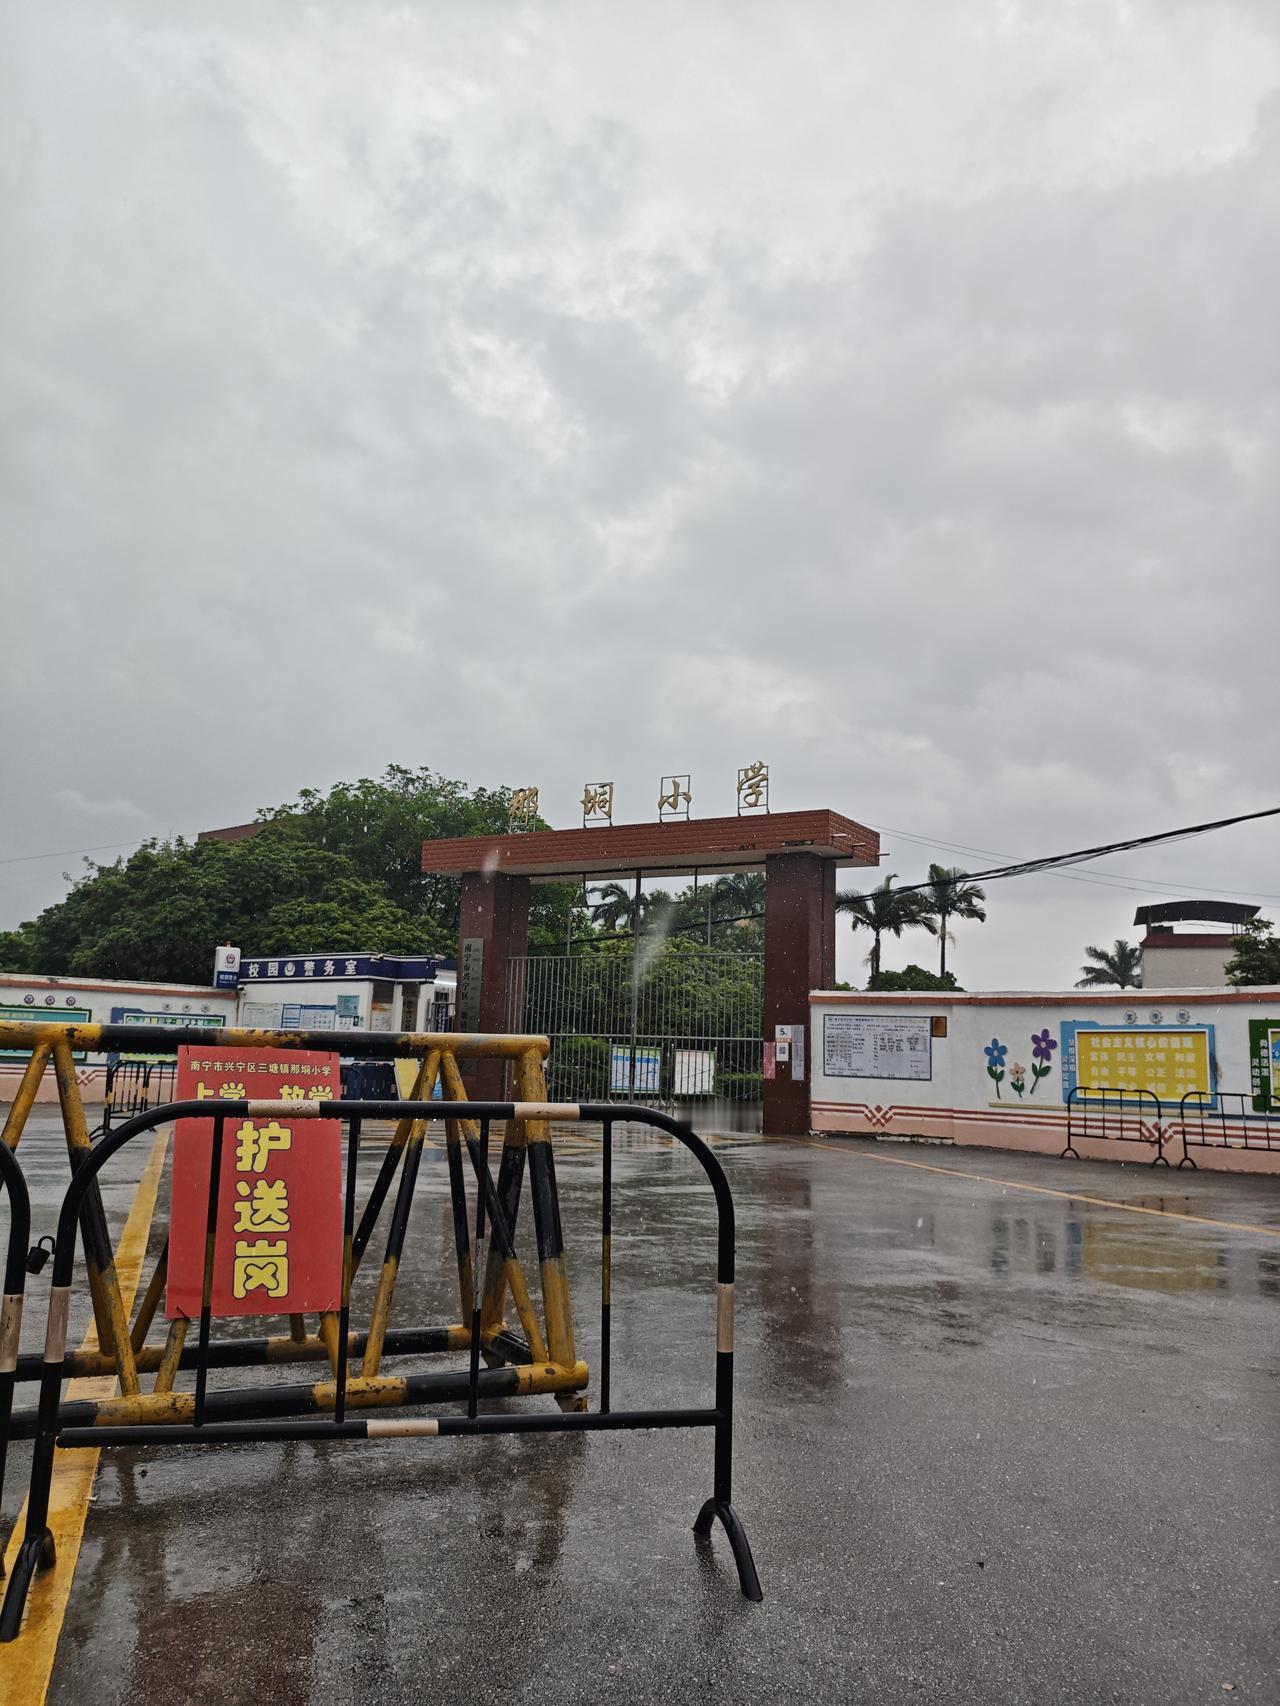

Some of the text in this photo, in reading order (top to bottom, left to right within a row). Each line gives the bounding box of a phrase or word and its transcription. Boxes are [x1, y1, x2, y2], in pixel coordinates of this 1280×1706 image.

[508, 760, 768, 825] 那垌小学
[248, 959, 358, 978] 校园警务室
[190, 1060, 331, 1077] 南宁市兴宁区三塘镇那垌小学
[232, 1120, 292, 1299] 护送岗
